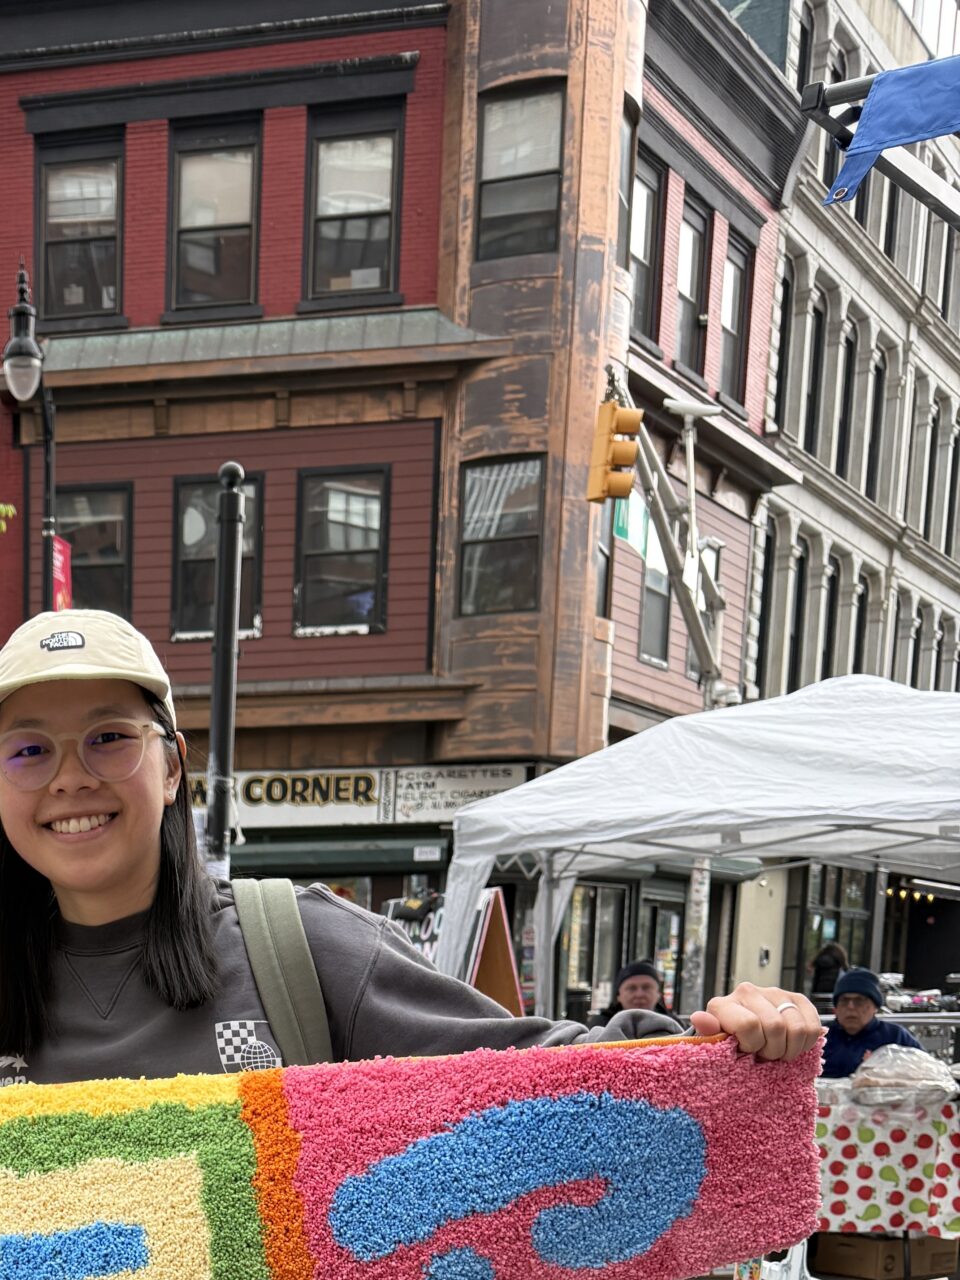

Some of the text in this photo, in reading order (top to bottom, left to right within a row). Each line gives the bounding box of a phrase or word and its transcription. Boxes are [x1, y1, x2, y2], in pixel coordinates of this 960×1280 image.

[405, 768, 512, 780] CIGARETTES
[242, 773, 380, 807] CORNER
[405, 781, 436, 789] ATM
